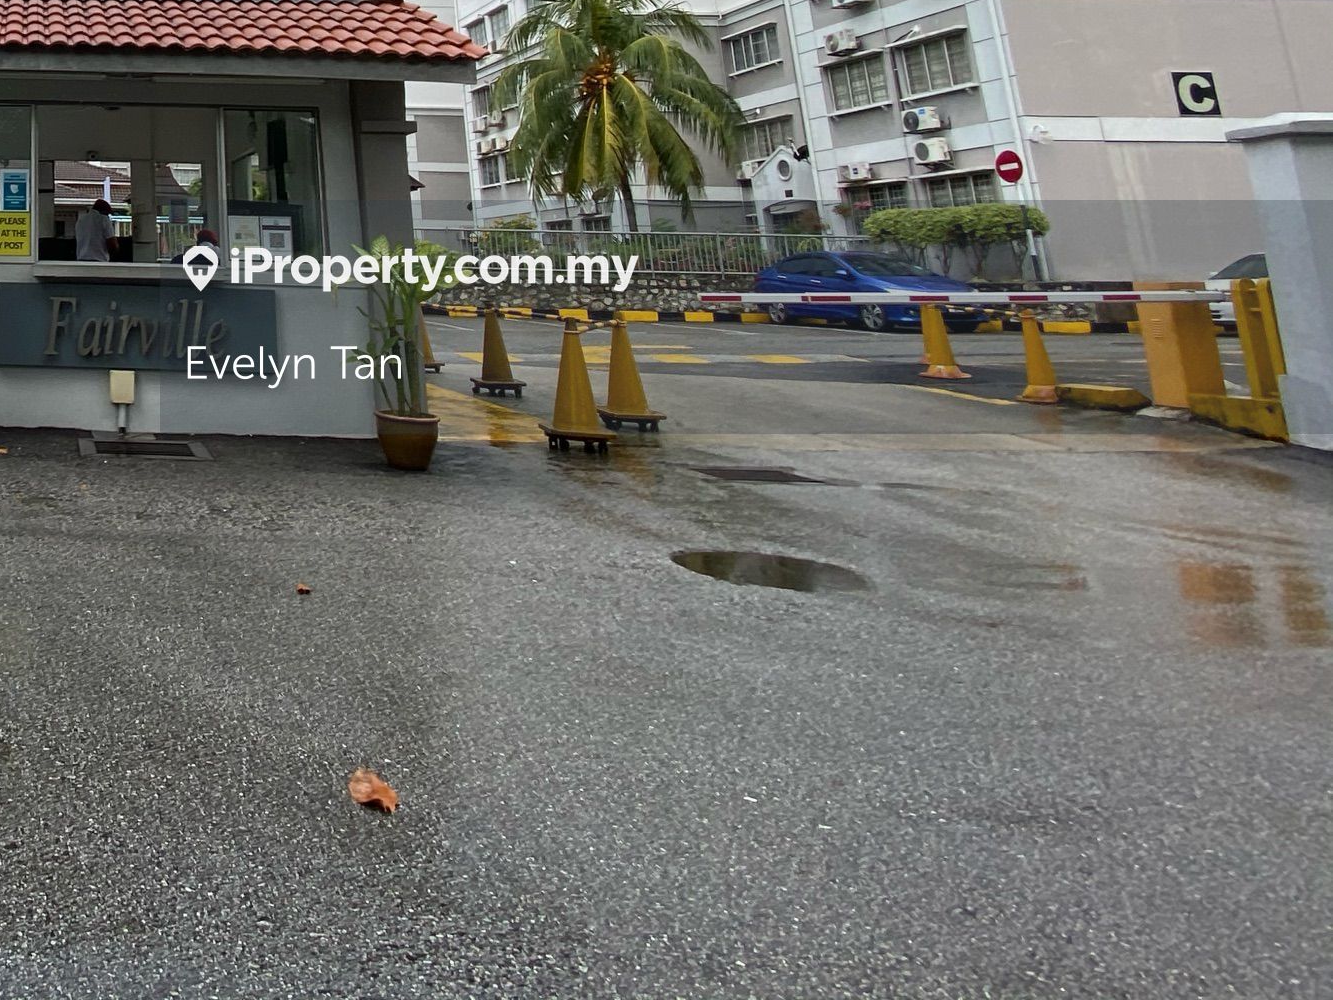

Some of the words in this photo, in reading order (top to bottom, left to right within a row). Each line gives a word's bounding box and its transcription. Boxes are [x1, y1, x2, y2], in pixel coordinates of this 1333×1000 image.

[1178, 74, 1215, 113] C
[0, 217, 27, 225] PLEASE
[0, 229, 11, 237] AT
[12, 229, 27, 238] THE
[4, 241, 24, 249] POST
[44, 295, 229, 359] Fairville
